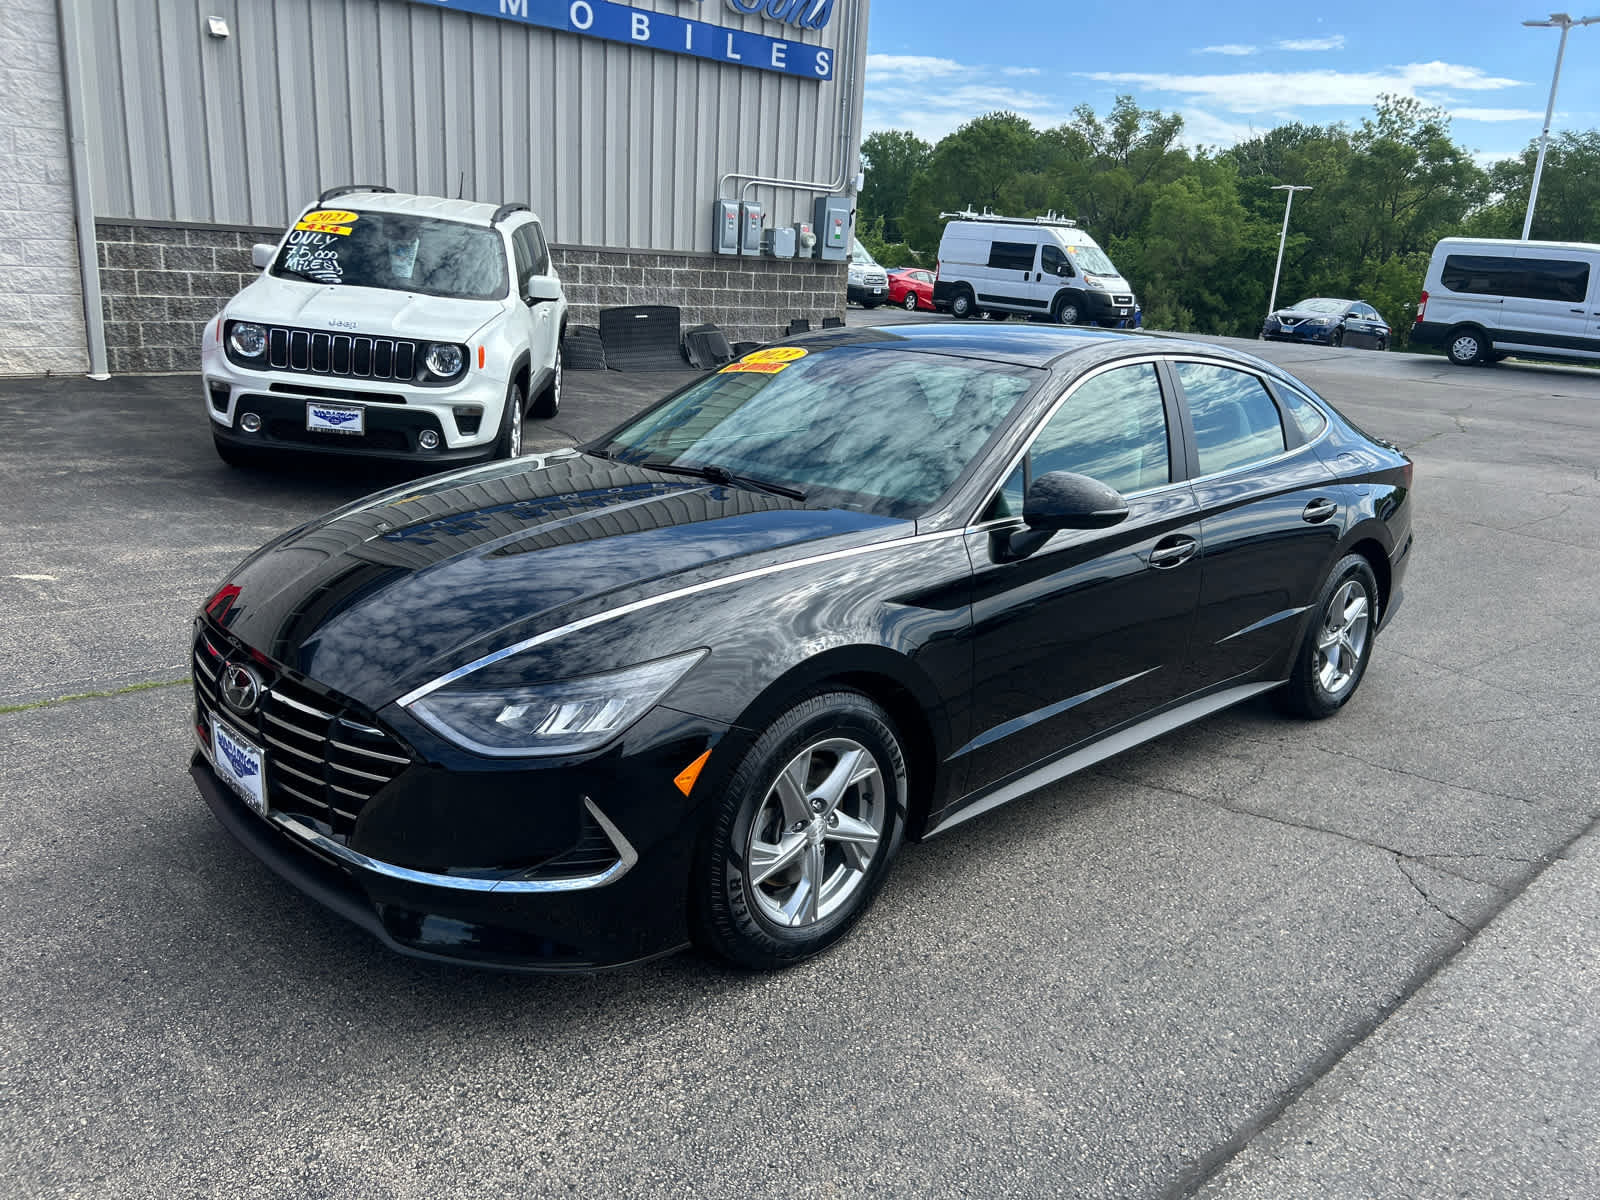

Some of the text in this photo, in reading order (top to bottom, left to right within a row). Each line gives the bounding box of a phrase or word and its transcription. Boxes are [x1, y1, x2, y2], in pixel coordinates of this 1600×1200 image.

[435, 0, 830, 76] MOBILES
[289, 230, 338, 249] ONLY
[285, 245, 338, 261] 75,000
[328, 319, 358, 329] Jeep
